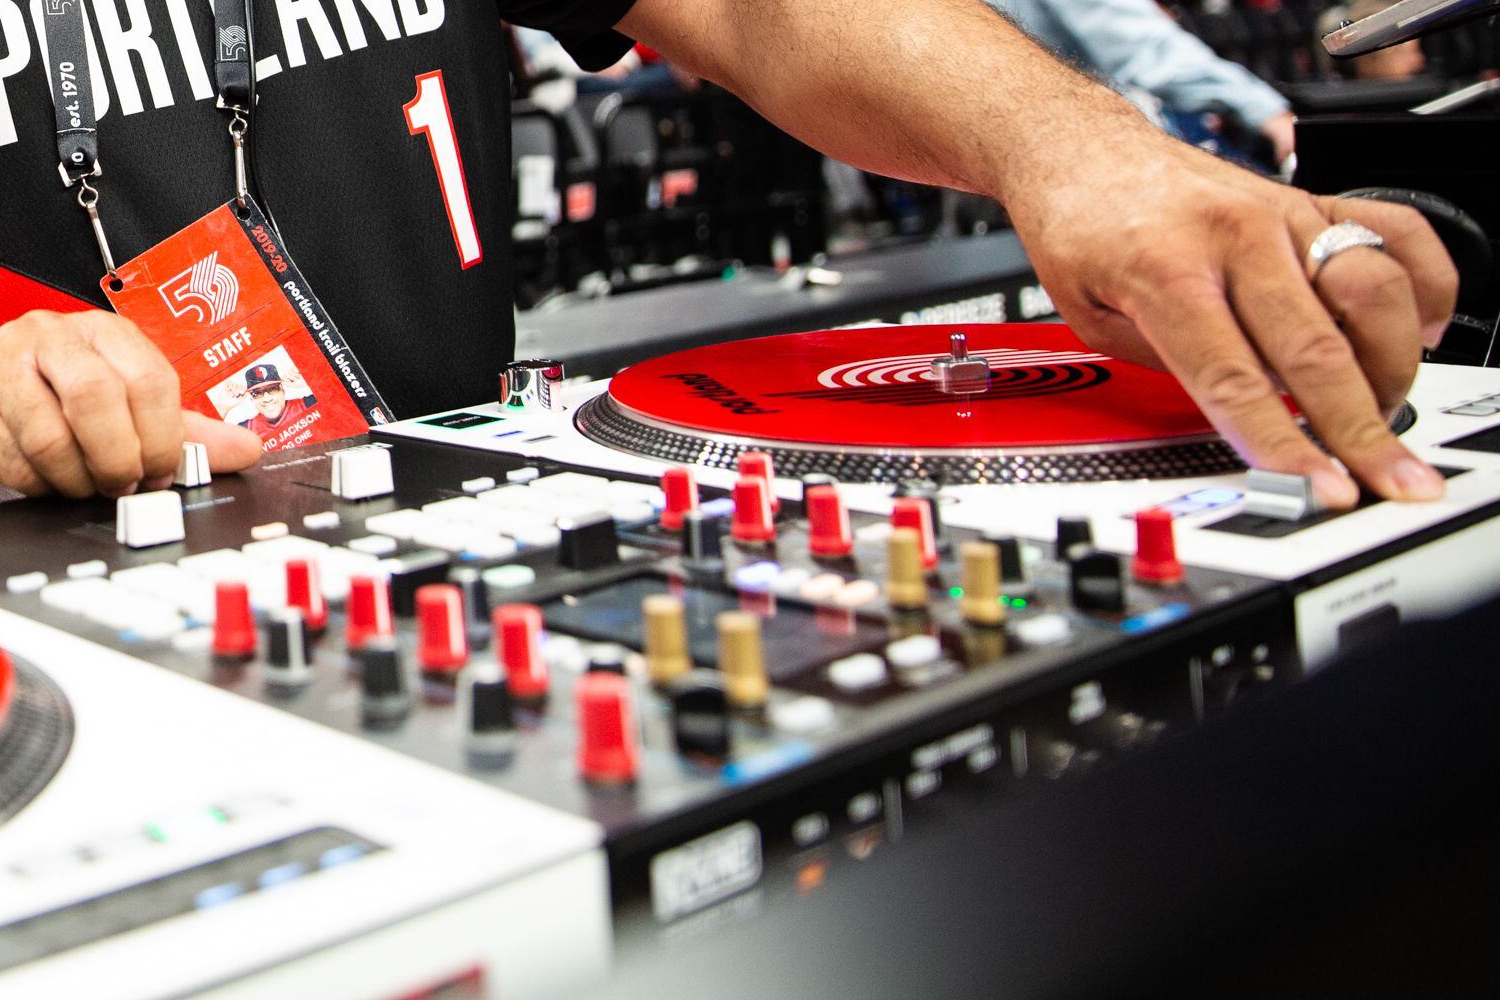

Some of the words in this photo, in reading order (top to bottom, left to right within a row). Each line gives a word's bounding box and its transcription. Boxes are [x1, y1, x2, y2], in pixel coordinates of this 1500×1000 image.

[59, 62, 77, 98] 1970
[66, 101, 80, 127] est.
[402, 69, 484, 270] 1
[251, 225, 289, 273] 2019-20
[203, 326, 252, 368] STAFF
[283, 280, 325, 331] portland
[319, 327, 340, 357] trail
[334, 346, 368, 399] blazers
[261, 437, 278, 453] VID
[278, 409, 321, 443] JACKSON
[294, 429, 313, 445] ONE
